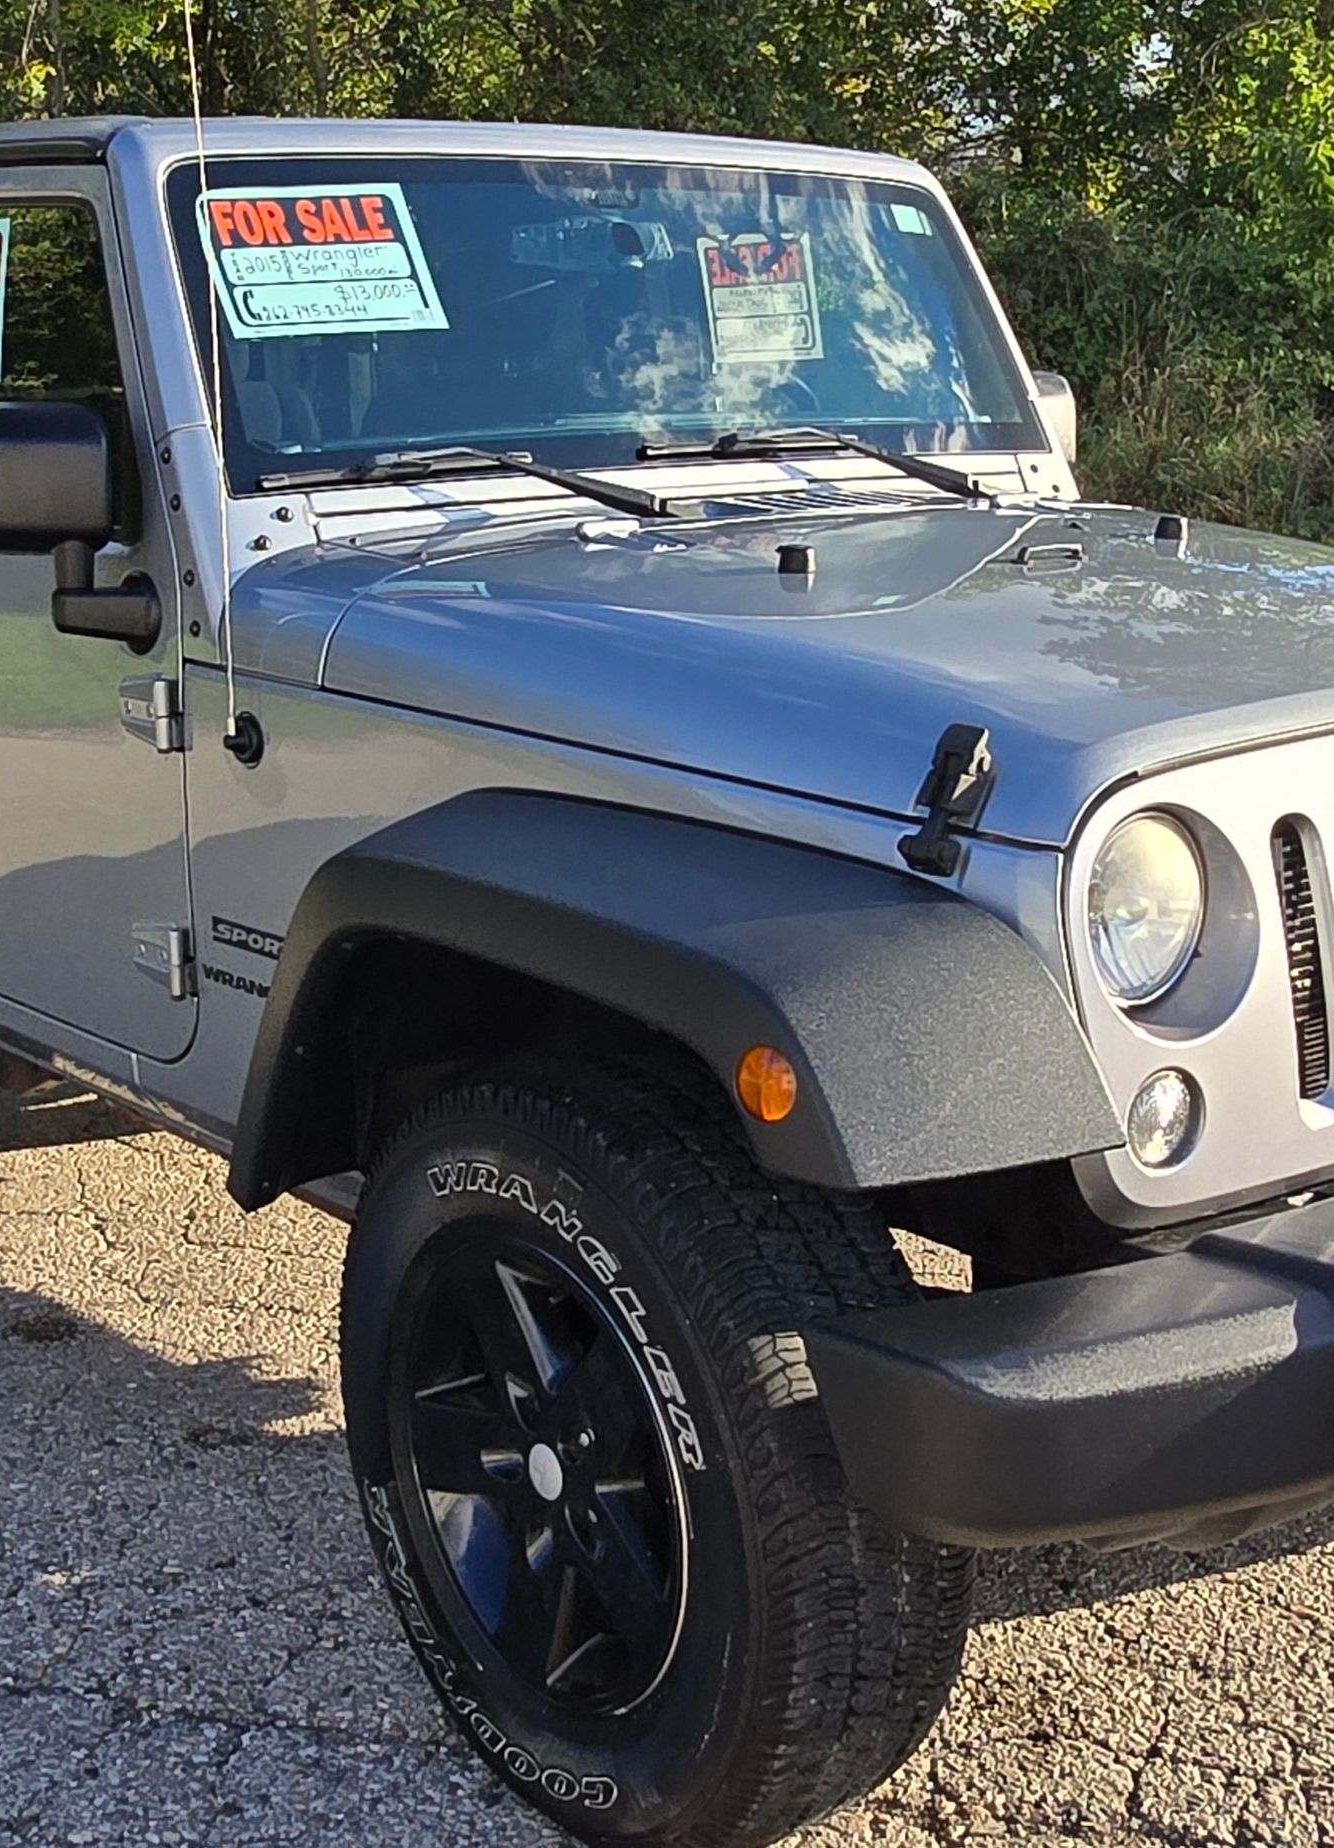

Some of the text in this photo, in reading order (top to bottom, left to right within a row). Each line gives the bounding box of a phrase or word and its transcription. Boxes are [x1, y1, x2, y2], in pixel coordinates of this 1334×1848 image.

[210, 196, 394, 246] FOR SALE
[243, 255, 282, 275] 2015
[289, 246, 382, 268] Wrangler
[214, 923, 284, 956] SPOR
[426, 1161, 707, 1471] WRANGLER
